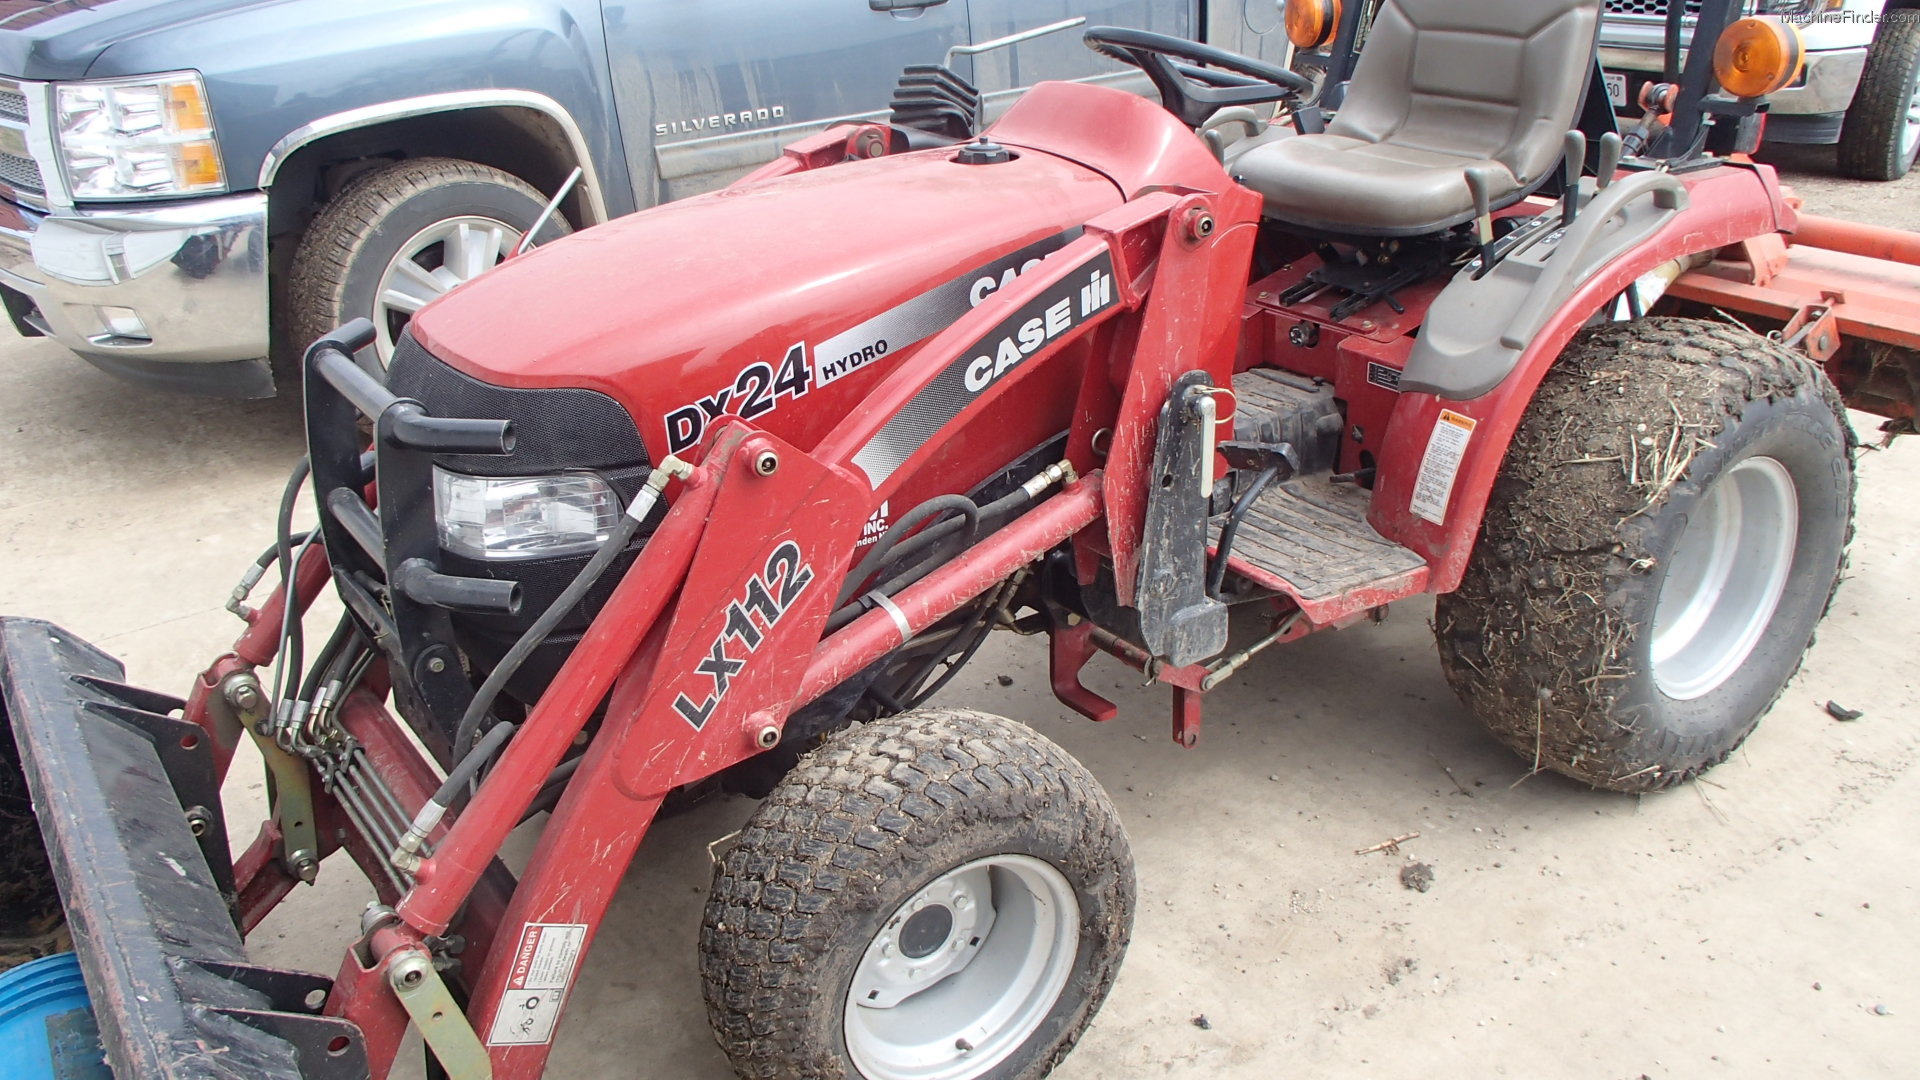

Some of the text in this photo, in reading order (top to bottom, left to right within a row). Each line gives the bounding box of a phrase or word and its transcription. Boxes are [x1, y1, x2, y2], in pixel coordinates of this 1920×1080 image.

[655, 105, 785, 136] SILVERADO
[964, 296, 1072, 392] CASE
[664, 339, 888, 455] DX24 HYDRO
[863, 519, 889, 536] INC.
[671, 539, 815, 732] LX112
[516, 930, 538, 974] DANGER
